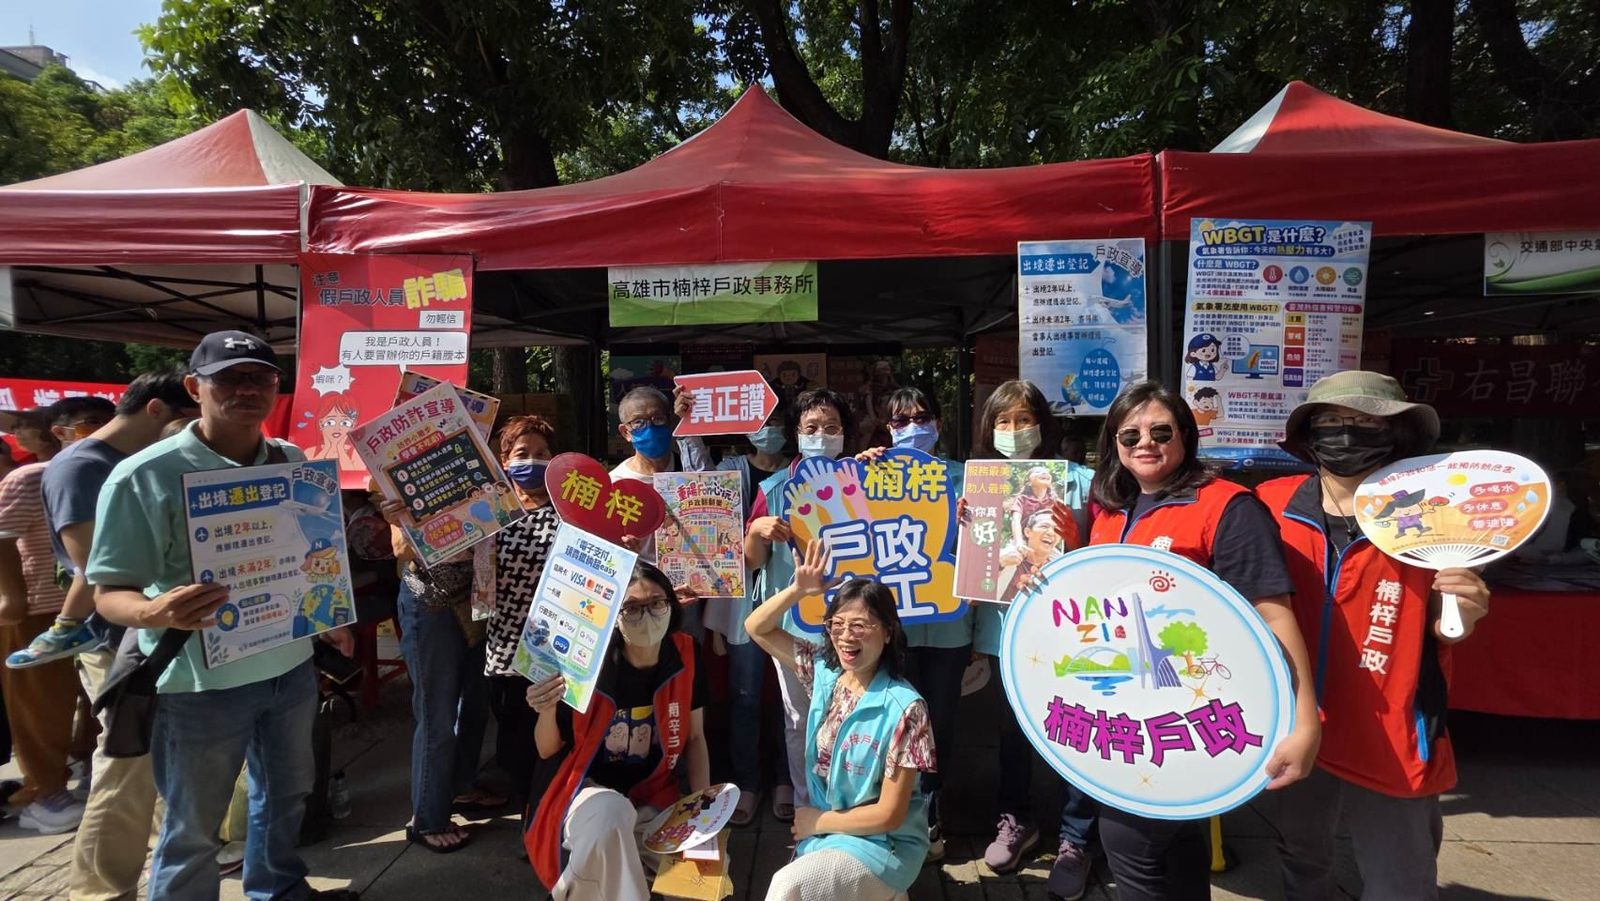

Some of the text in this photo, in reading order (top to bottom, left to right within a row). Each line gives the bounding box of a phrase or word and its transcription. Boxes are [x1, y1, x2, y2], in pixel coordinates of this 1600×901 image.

[1023, 258, 1089, 272] 出境遷出登記
[1095, 244, 1143, 277] 戶政宣導
[312, 272, 340, 286] 注意
[404, 268, 467, 309] 詐騙
[612, 274, 814, 299] 高雄市楠梓戶政事務所
[320, 288, 404, 306] 假戶政人員
[426, 314, 456, 323] 勿輕信
[342, 350, 465, 360] 有人要冒辦你的戶籍謄本
[365, 337, 440, 347] 我是戶政人員！
[1461, 360, 1600, 404] 右昌聯
[691, 383, 765, 424] 真正讚
[367, 398, 456, 455] 戶政防詐宣導
[292, 467, 338, 495] 戶政宣導
[864, 459, 946, 500] 楠梓
[1474, 484, 1514, 496] 多喝水
[198, 484, 286, 509] 出境遷出登記
[561, 469, 644, 526] 楠梓
[1463, 501, 1503, 512] 多休息
[973, 521, 997, 545] 好
[822, 518, 927, 576] 戶政
[570, 570, 586, 587] VISA
[1052, 595, 1128, 627] NAN
[1359, 579, 1402, 674] 楠梓戶政
[1043, 695, 1263, 768] 楠梓戶政
